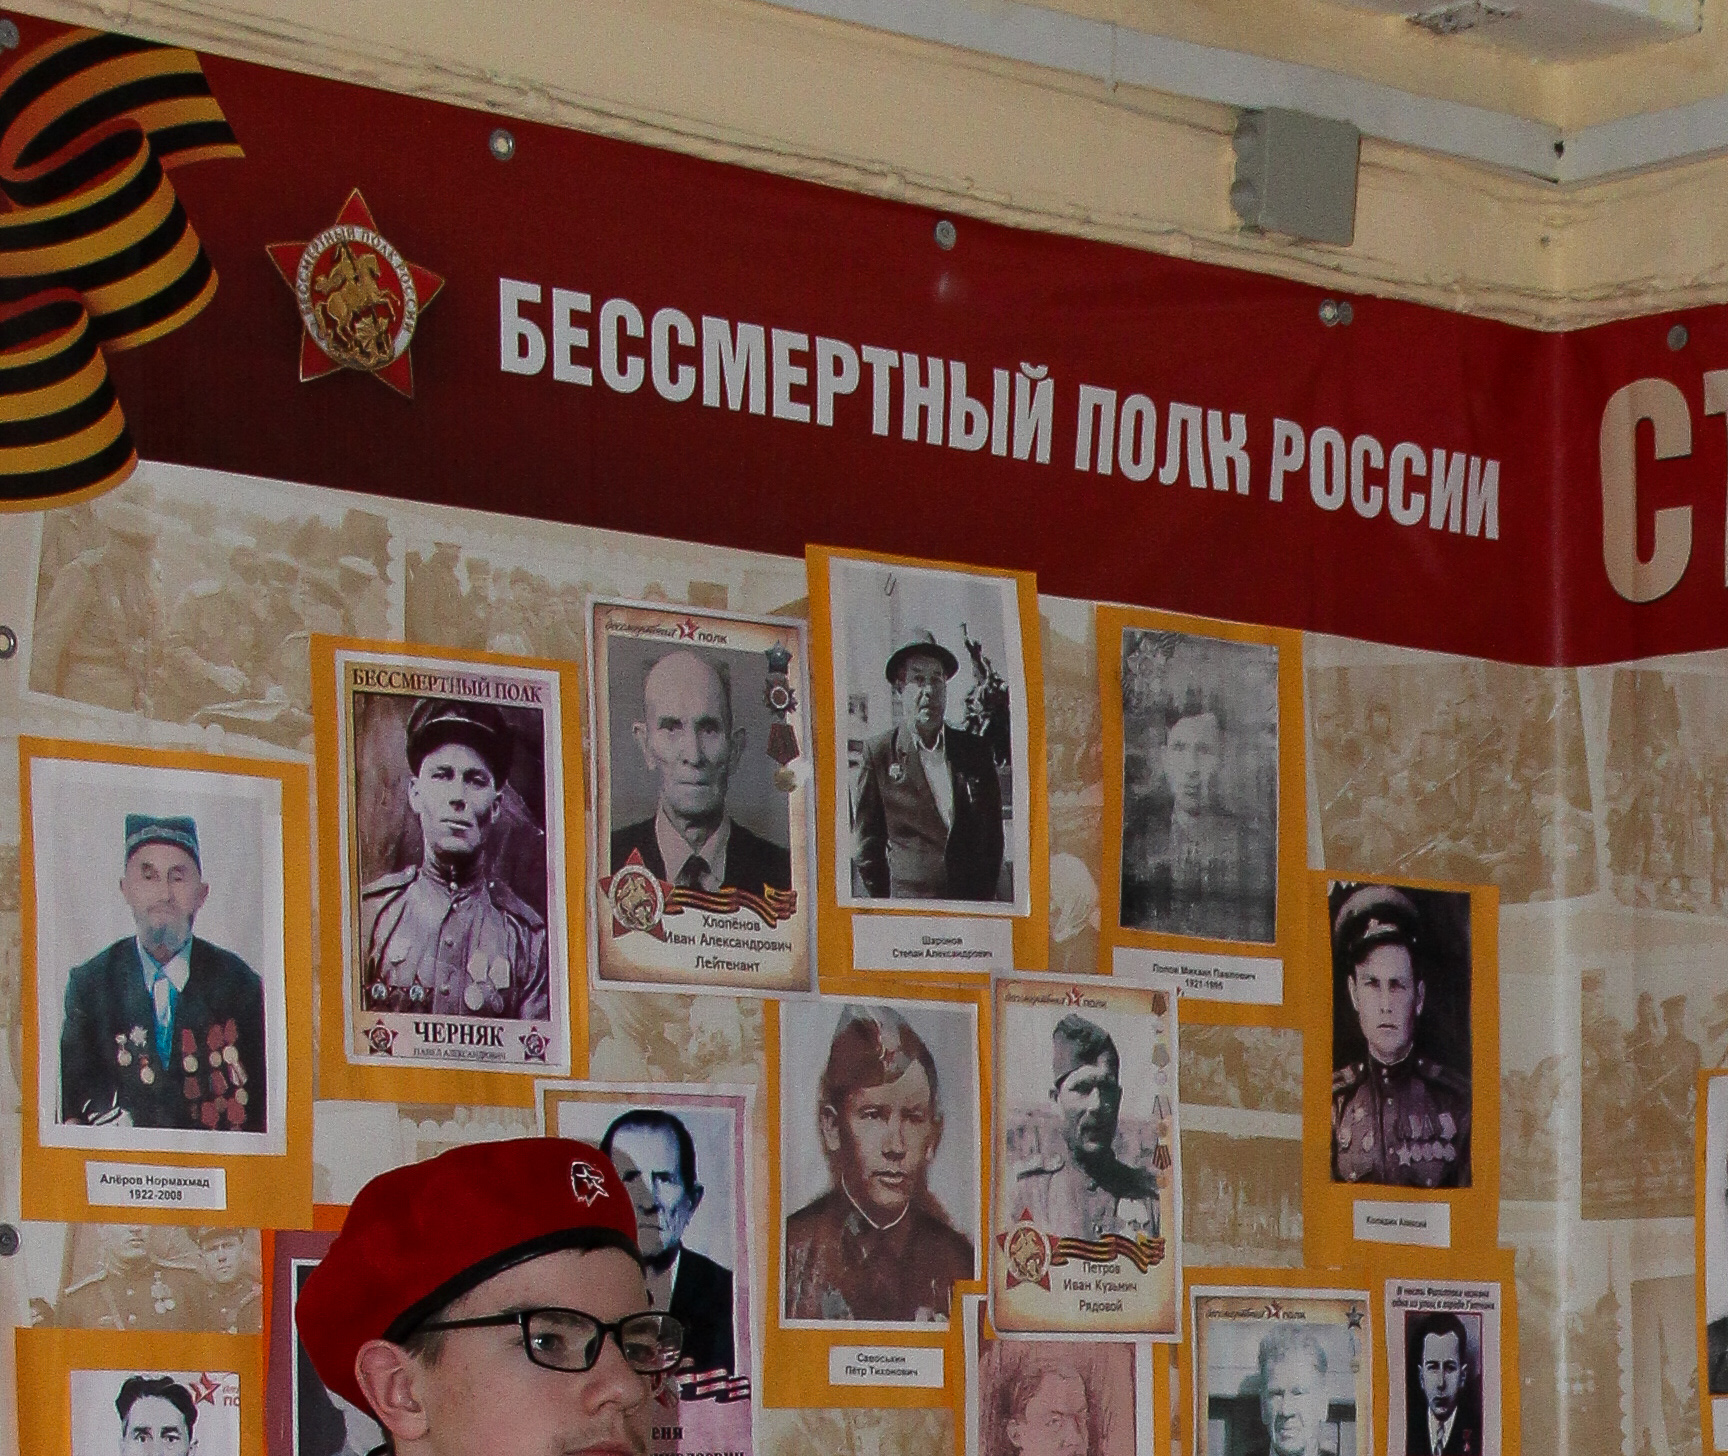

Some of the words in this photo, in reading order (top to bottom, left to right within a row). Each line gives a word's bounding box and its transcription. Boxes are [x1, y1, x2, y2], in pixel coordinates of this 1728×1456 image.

[499, 277, 1053, 465] БЕССМЕРТНЫЙ
[1075, 384, 1250, 495] ПОЛК
[1269, 418, 1501, 540] РОССИИ
[353, 668, 492, 700] БЕССМЕРТНЫЙ
[495, 682, 542, 703] ПОЛК
[703, 915, 761, 931] Хлопёнов
[664, 931, 696, 945] Иван
[700, 934, 792, 953] Александрович
[695, 956, 761, 972] Лейтенант
[414, 1022, 505, 1047] ЧЕРНЯК
[146, 1177, 210, 1190] Нормахмад
[1083, 1262, 1120, 1277] Петров
[1063, 1280, 1092, 1291] Иван
[1095, 1280, 1138, 1295] Кузьмич
[1079, 1300, 1123, 1315] Рядовой
[870, 1366, 919, 1378] Тихонович
[651, 1426, 684, 1441] еня
